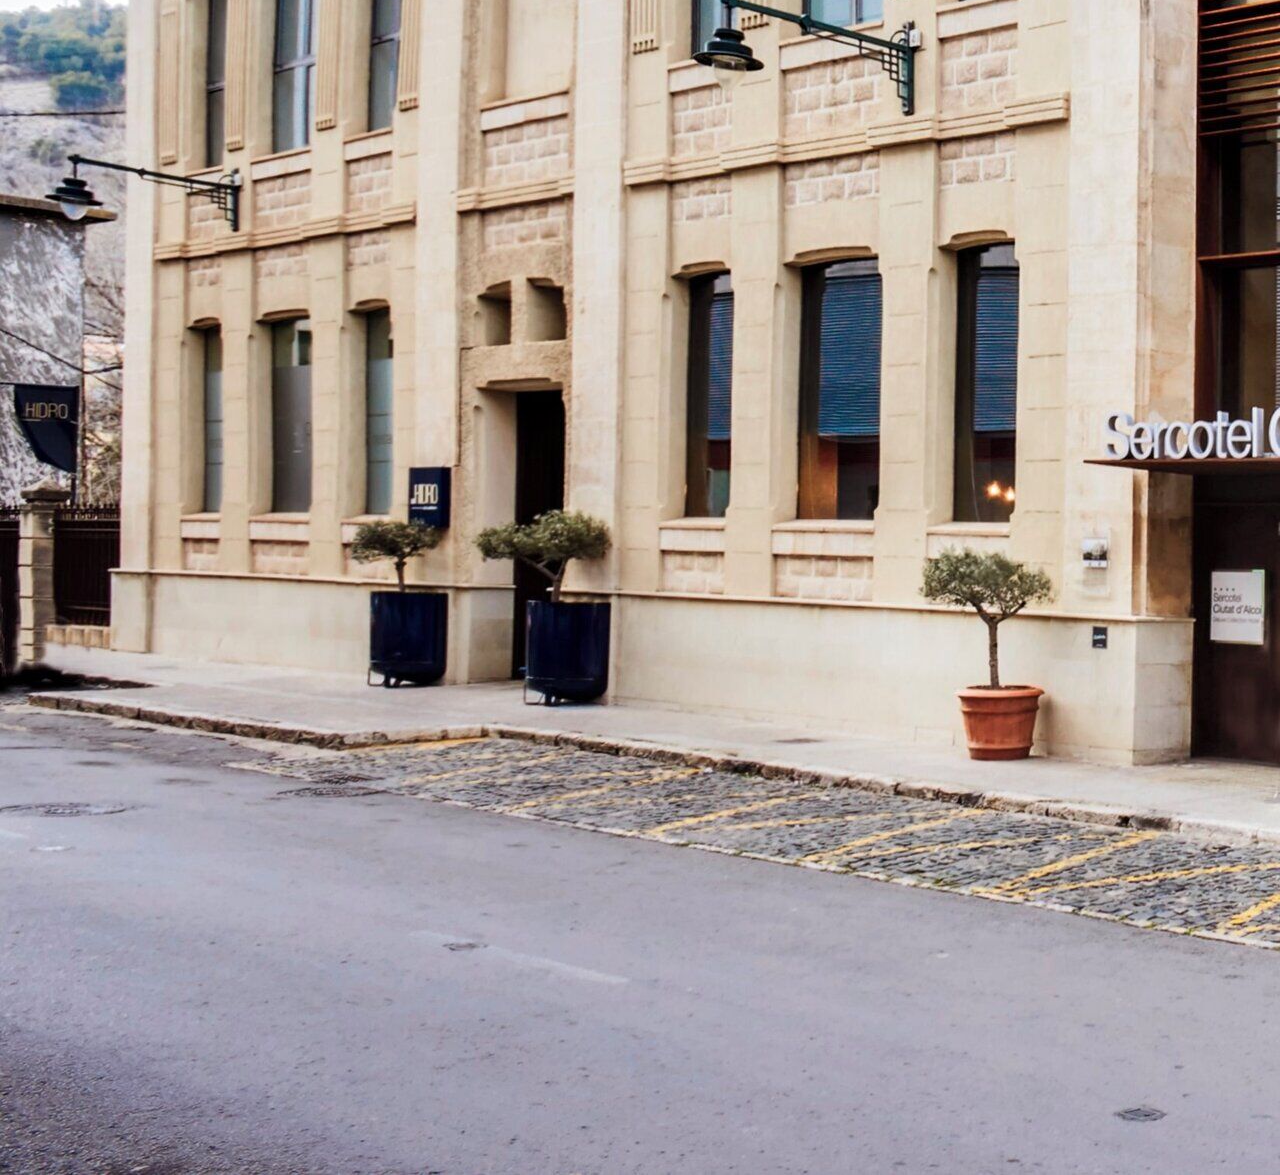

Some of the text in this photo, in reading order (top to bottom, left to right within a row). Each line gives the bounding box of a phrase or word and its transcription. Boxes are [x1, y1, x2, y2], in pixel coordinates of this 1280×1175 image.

[25, 401, 69, 419] HIDRO
[1103, 406, 1264, 460] Sercotel
[1213, 592, 1242, 603] Sercotel
[1212, 603, 1235, 614] Ciutat
